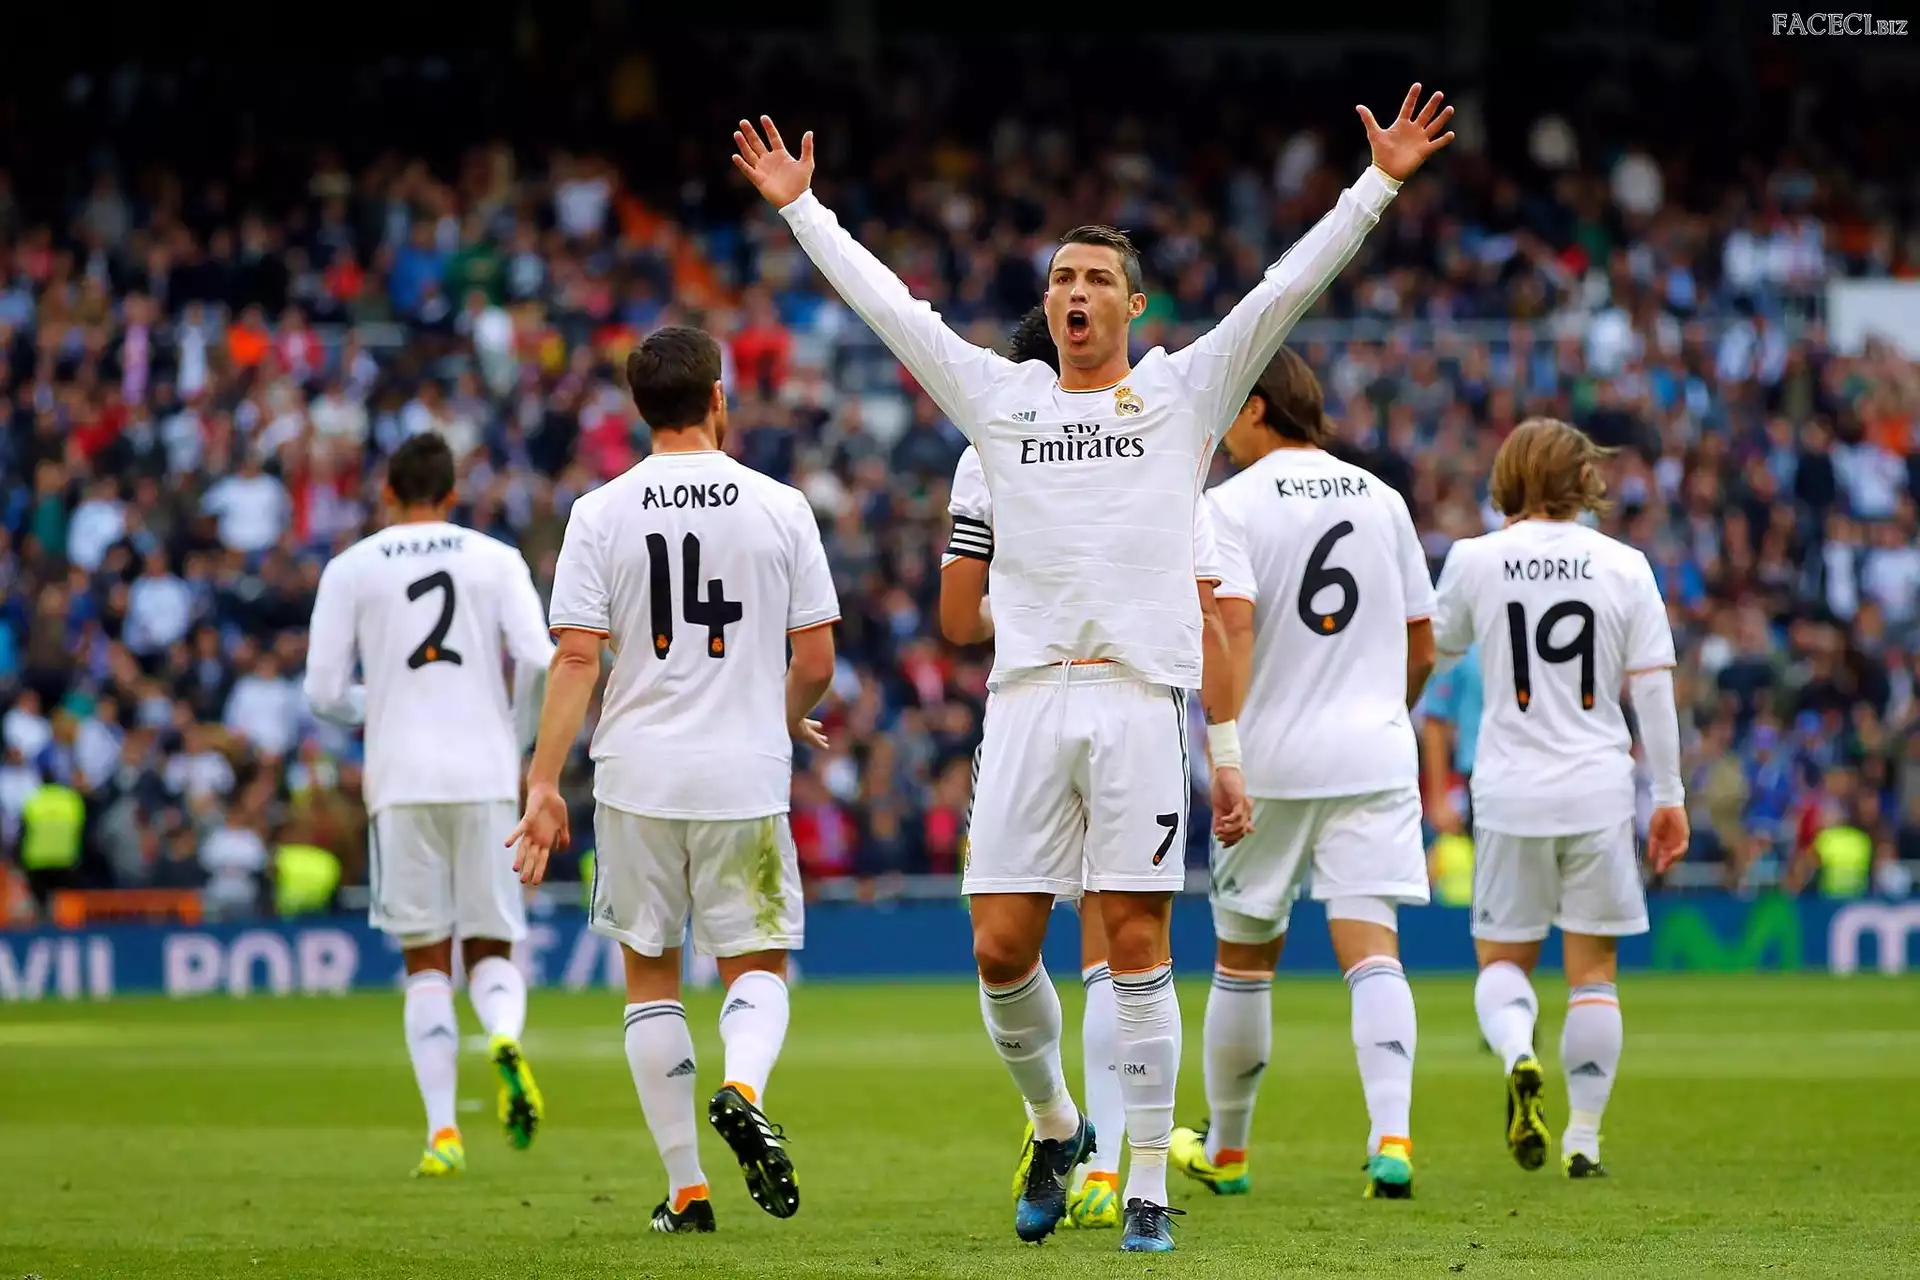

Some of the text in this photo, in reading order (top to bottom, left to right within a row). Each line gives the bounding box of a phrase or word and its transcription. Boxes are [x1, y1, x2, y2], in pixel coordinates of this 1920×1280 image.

[1020, 433, 1145, 465] Emirates
[641, 483, 739, 510] ALONSO
[1275, 476, 1372, 499] KHEDIRA
[645, 531, 743, 660] 14
[1298, 520, 1359, 636] 6
[407, 570, 462, 670] 2
[1507, 600, 1594, 712] 19
[1152, 812, 1179, 866] 7
[1123, 1063, 1147, 1075] RM
